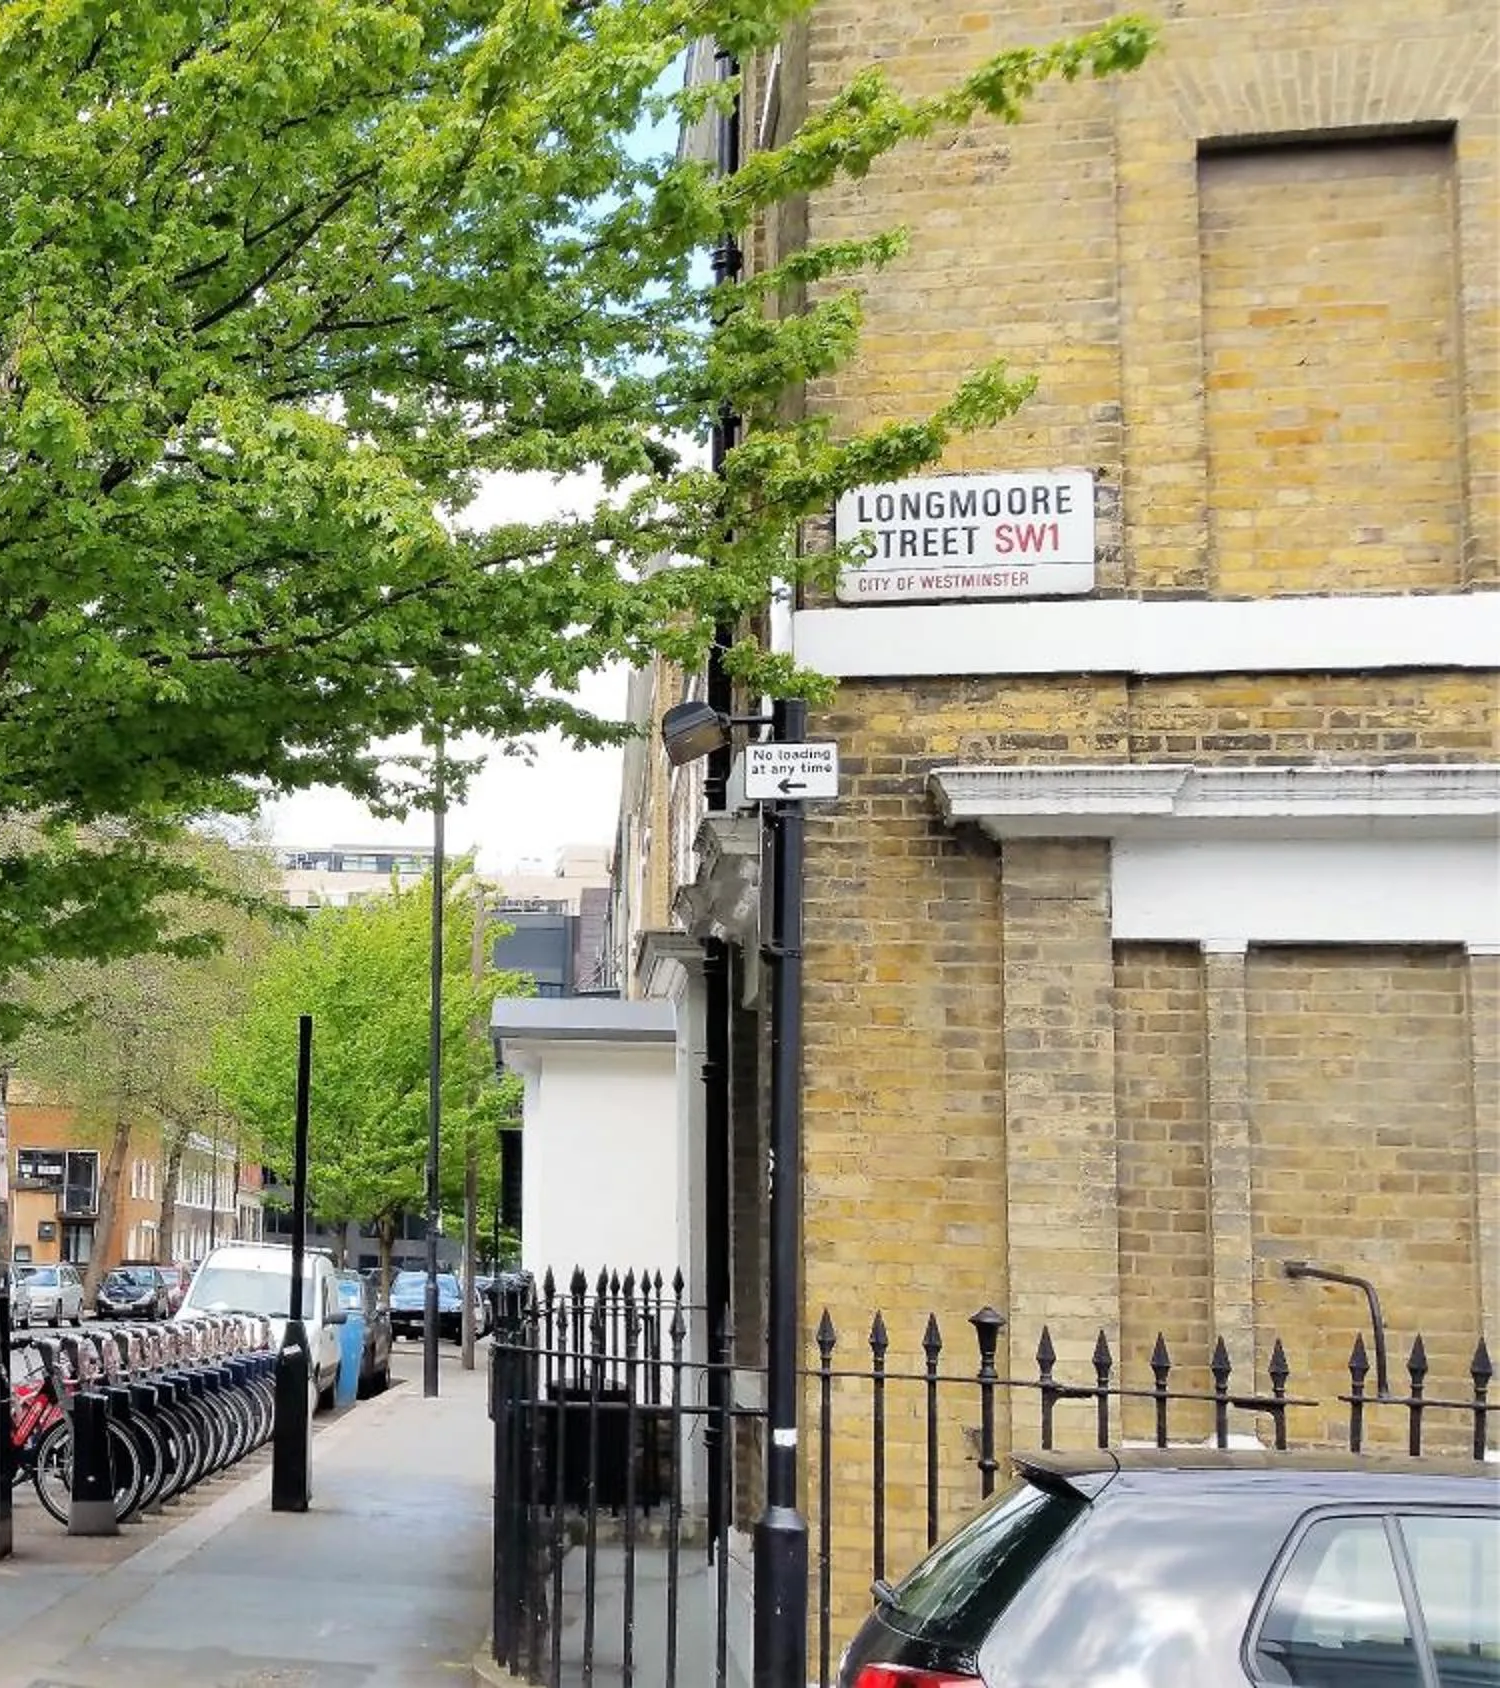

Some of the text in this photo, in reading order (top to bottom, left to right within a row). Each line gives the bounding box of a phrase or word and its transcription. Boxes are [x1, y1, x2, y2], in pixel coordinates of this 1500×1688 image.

[857, 485, 1073, 523] LONGMOORE
[994, 523, 1061, 554] SW1
[858, 571, 1030, 593] CITY OF WESTMINSTER
[753, 747, 831, 761] No loading
[751, 761, 833, 776] at any time
